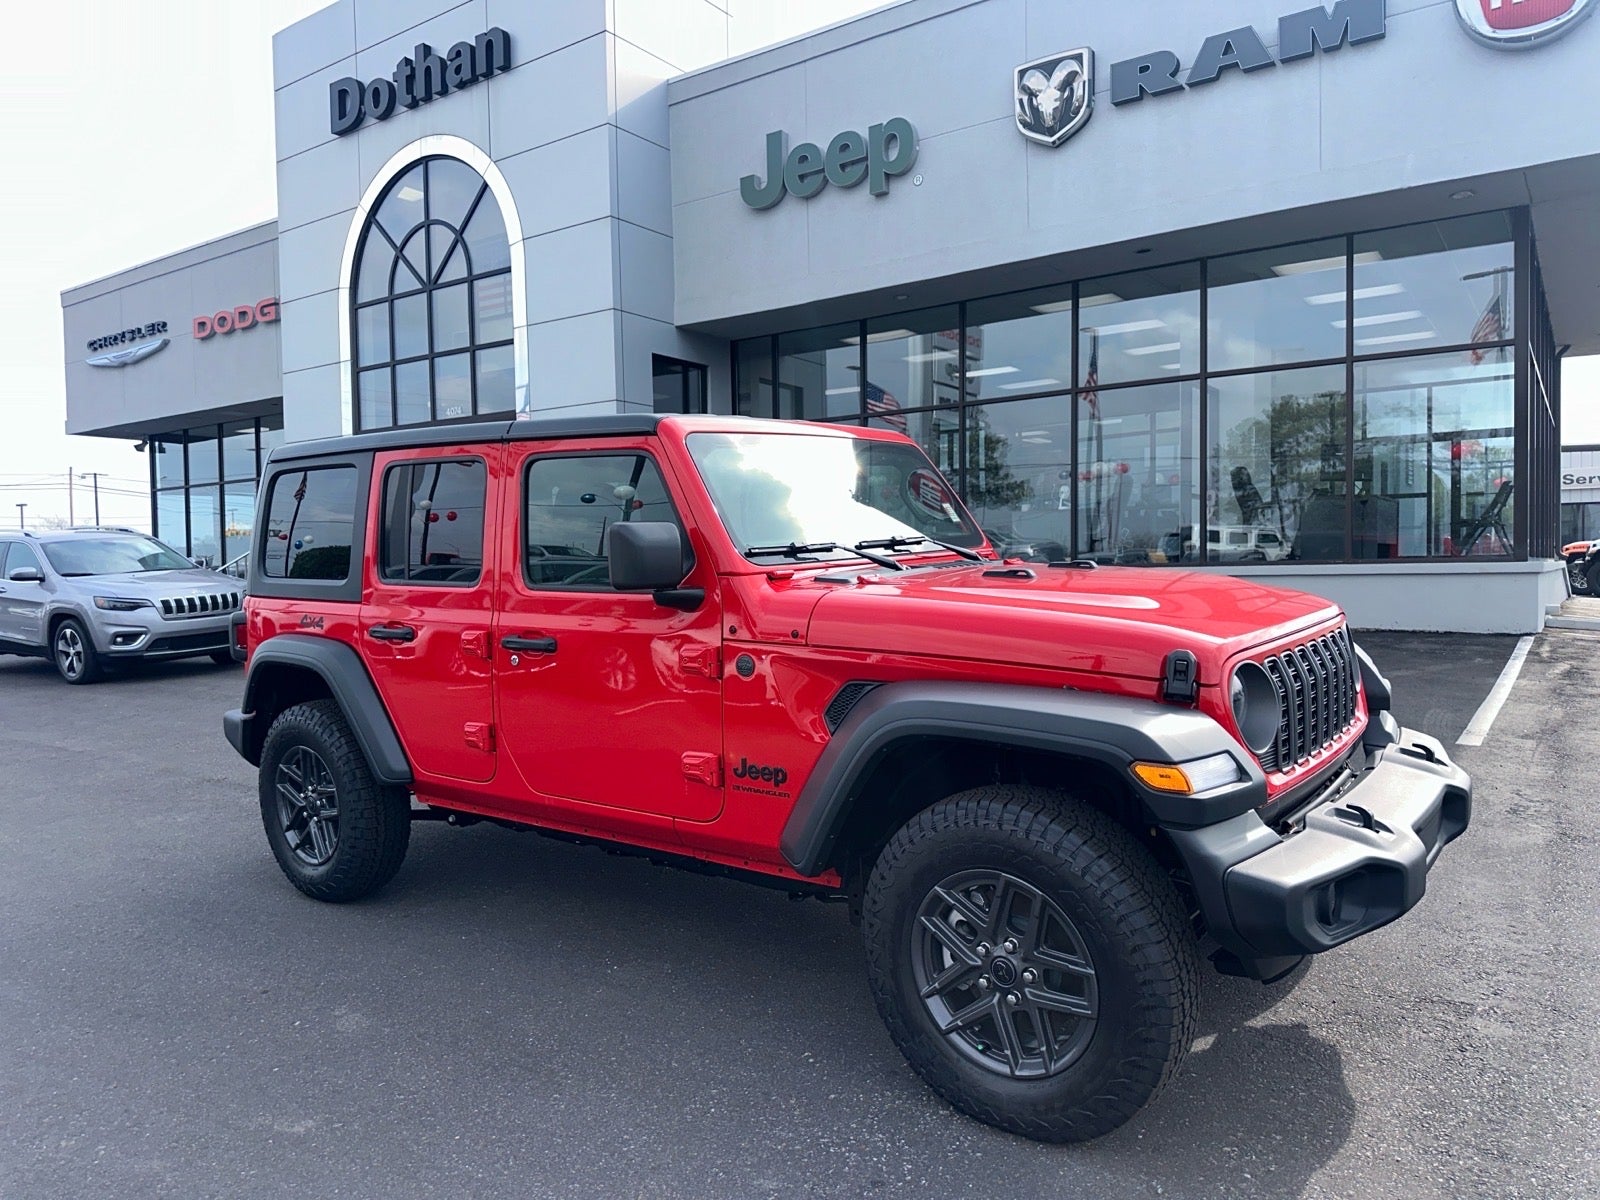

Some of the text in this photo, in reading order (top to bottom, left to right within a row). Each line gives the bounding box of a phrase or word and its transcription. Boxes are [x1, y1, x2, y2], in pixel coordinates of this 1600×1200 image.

[329, 27, 511, 136] Dothan
[1110, 0, 1386, 107] RAM
[740, 117, 919, 210] Jeep
[87, 320, 168, 351] CHRYSLER
[193, 297, 279, 341] DODG
[733, 757, 787, 787] Jeep
